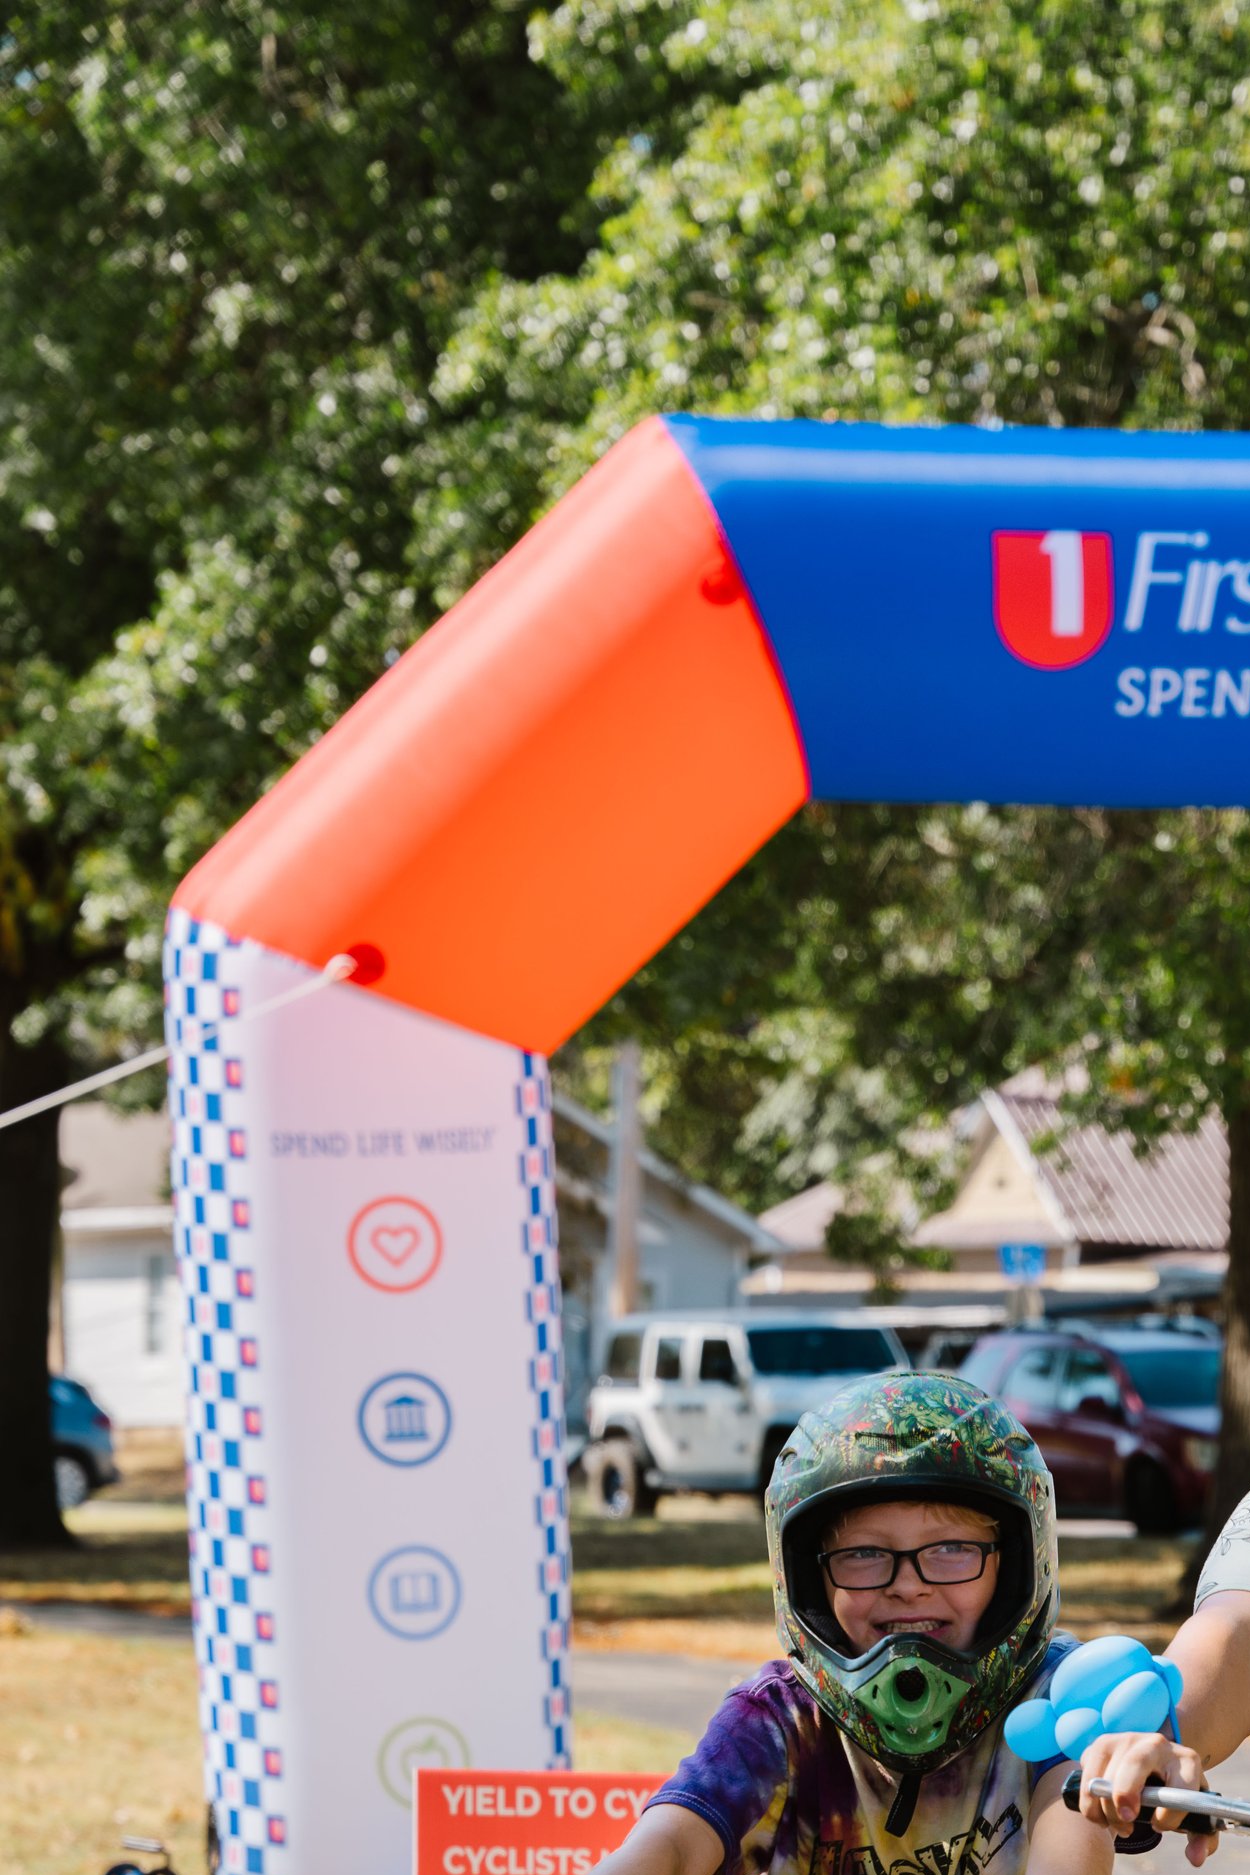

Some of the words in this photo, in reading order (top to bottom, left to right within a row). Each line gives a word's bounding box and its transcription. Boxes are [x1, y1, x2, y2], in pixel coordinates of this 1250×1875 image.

[270, 1129, 351, 1157] SPEND
[357, 1128, 406, 1157] LIFE
[413, 1123, 497, 1154] WISELY
[441, 1784, 542, 1817] YIELD
[548, 1786, 597, 1819] TO
